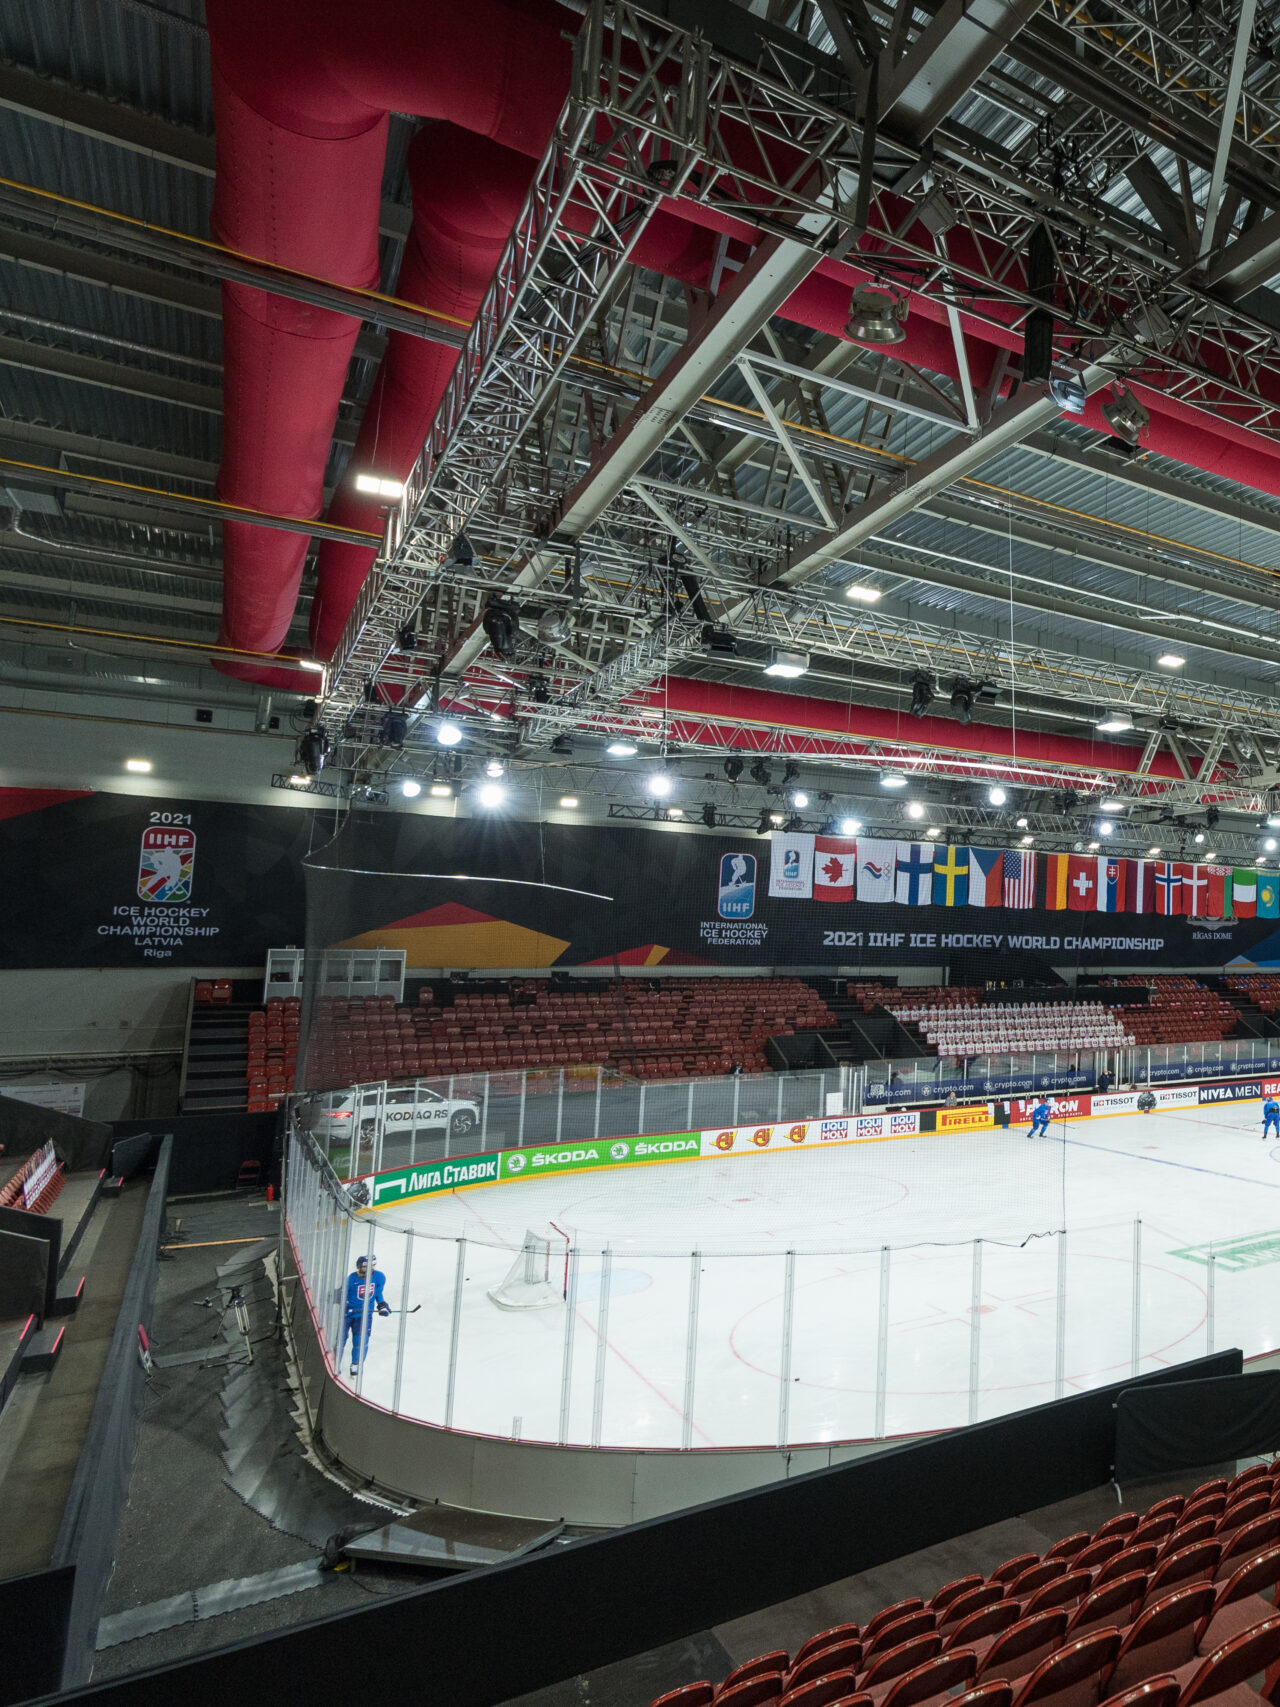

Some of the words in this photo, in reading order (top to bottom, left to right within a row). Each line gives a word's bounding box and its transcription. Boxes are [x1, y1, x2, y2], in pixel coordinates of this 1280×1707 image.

[150, 811, 192, 825] 2021
[149, 833, 190, 846] IIHF
[113, 906, 140, 916] ICE
[144, 907, 210, 917] HOCKEY
[722, 902, 750, 912] IIHF
[131, 917, 190, 927] WORLD
[700, 921, 768, 930] INTERNATIONAL
[97, 926, 219, 937] CHAMPIONSHIP
[700, 929, 719, 937] ICE
[722, 929, 768, 939] HOCKEY
[1213, 932, 1232, 940] DOME
[135, 937, 183, 946] LATVIA
[823, 931, 864, 947] 2021
[868, 933, 905, 947] IIHF
[909, 933, 936, 947] ICE
[941, 934, 1003, 948] HOCKEY
[1008, 935, 1060, 949] WORLD
[1064, 937, 1165, 951] CHAMPIONSHIP
[144, 949, 172, 958] Riga
[1194, 1065, 1224, 1076] crypto.com
[1237, 1062, 1265, 1072] crypto.com
[994, 1079, 1032, 1091] crypto.com
[1050, 1075, 1087, 1086] crypto.com
[933, 1083, 974, 1094] crypto.com
[1200, 1087, 1234, 1101] NIVEA
[1235, 1085, 1261, 1097] MEN
[1170, 1091, 1197, 1099] TISSOT
[1105, 1096, 1134, 1106] TISSOT
[385, 1110, 432, 1122] KODIAQ
[434, 1109, 448, 1119] RS
[890, 1115, 916, 1125] LIQUI
[942, 1111, 988, 1127] PIRELLI
[821, 1121, 848, 1131] LIQUI
[857, 1117, 883, 1128] LIQUI
[857, 1127, 883, 1137] MOLY
[890, 1124, 915, 1134] MOLY
[821, 1130, 848, 1141] MOLY
[635, 1140, 698, 1155] ŠKODA
[531, 1149, 599, 1167] ŠKODA
